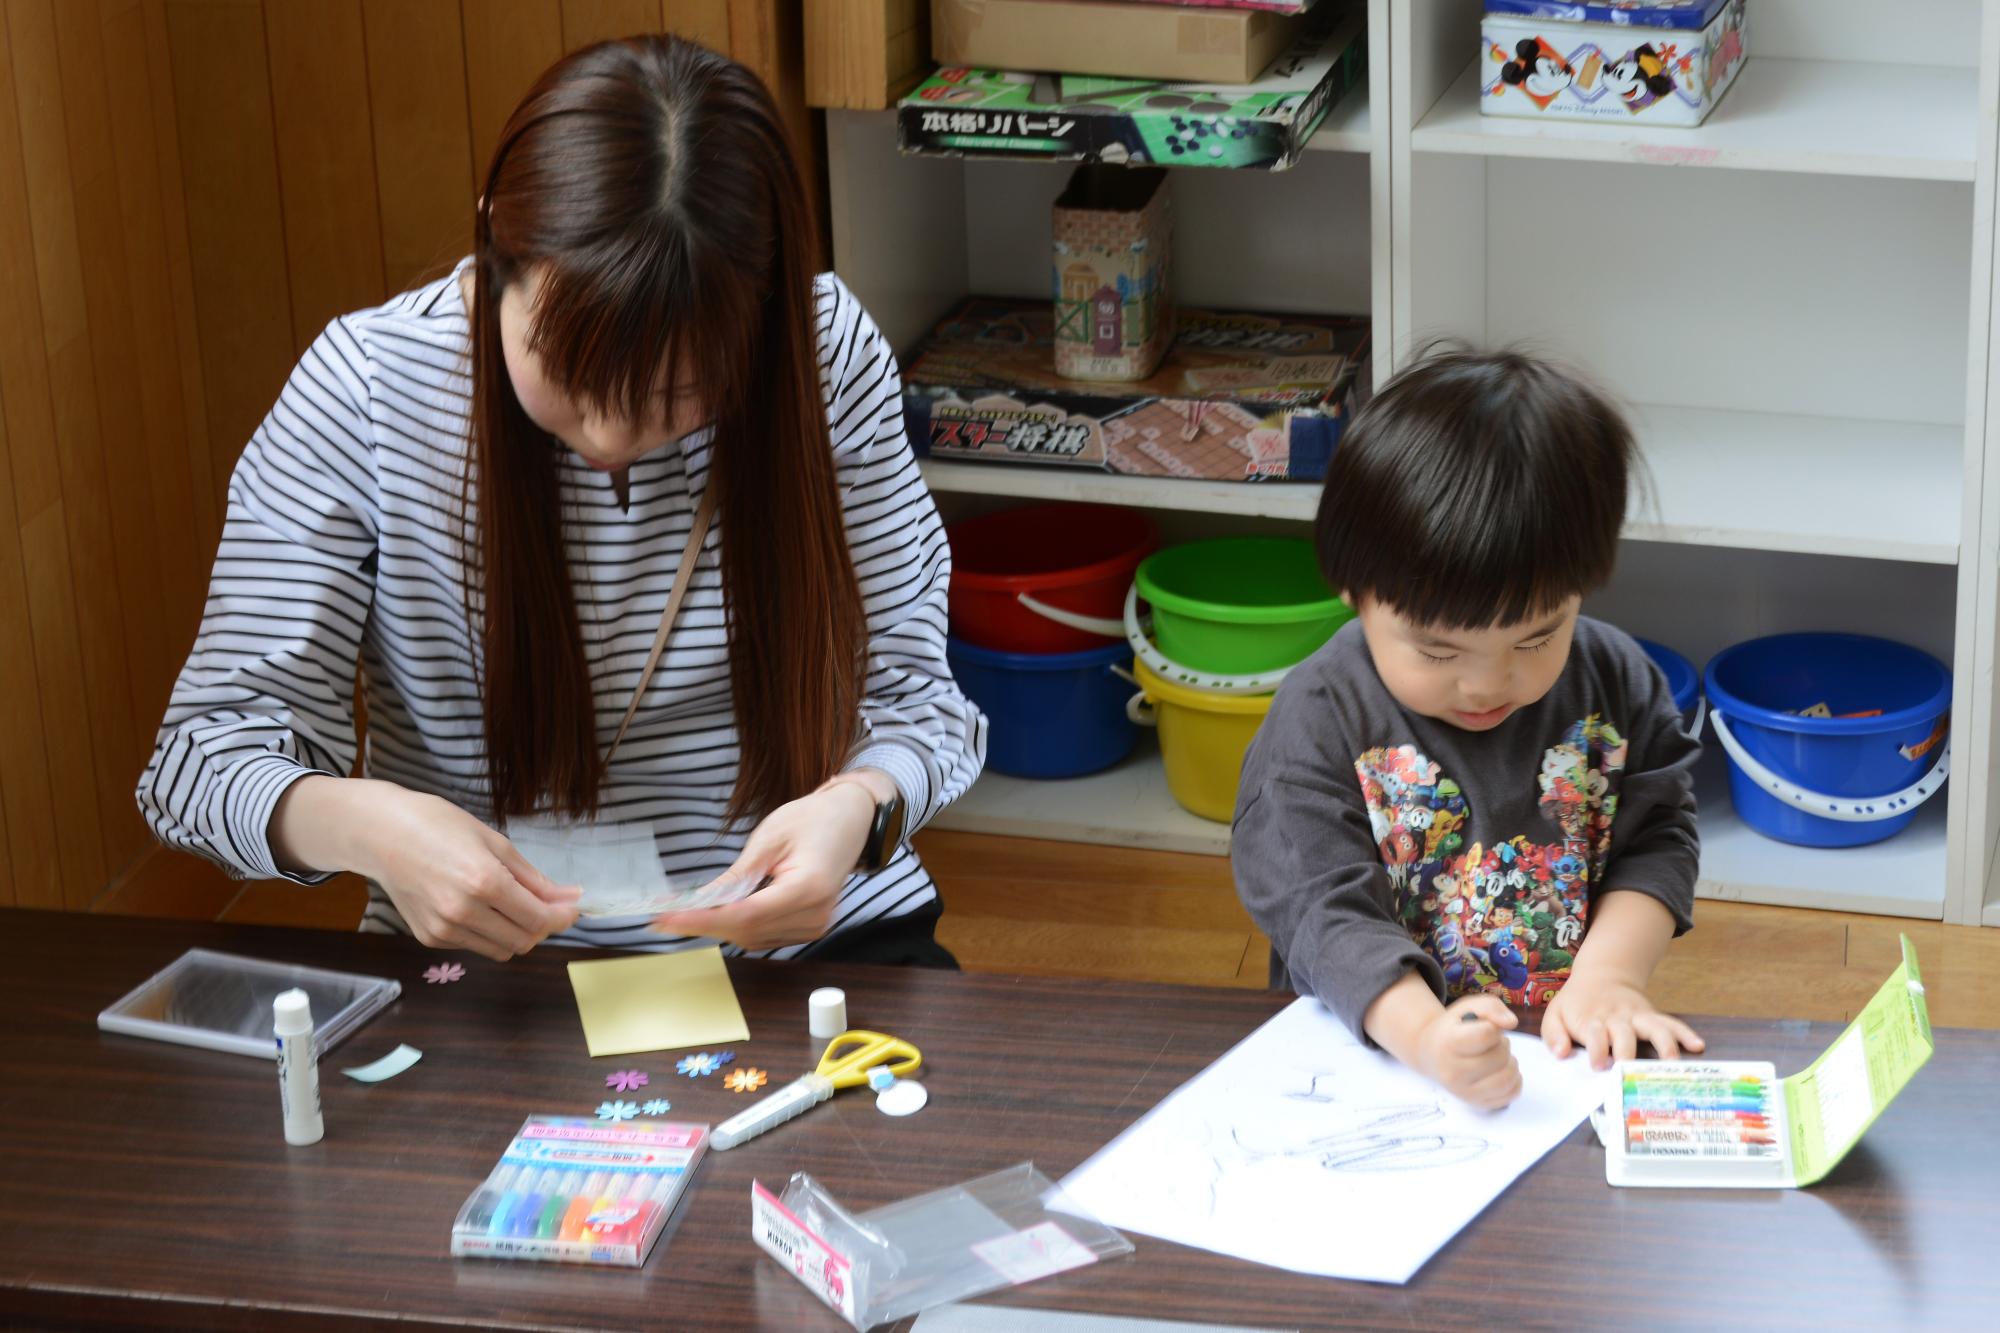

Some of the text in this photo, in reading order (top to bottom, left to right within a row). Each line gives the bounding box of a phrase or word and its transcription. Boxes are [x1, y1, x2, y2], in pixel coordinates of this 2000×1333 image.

[921, 112, 1076, 137] 本格リバーシ
[930, 422, 1088, 454] スター将棋
[767, 1229, 793, 1257] MIRROR
